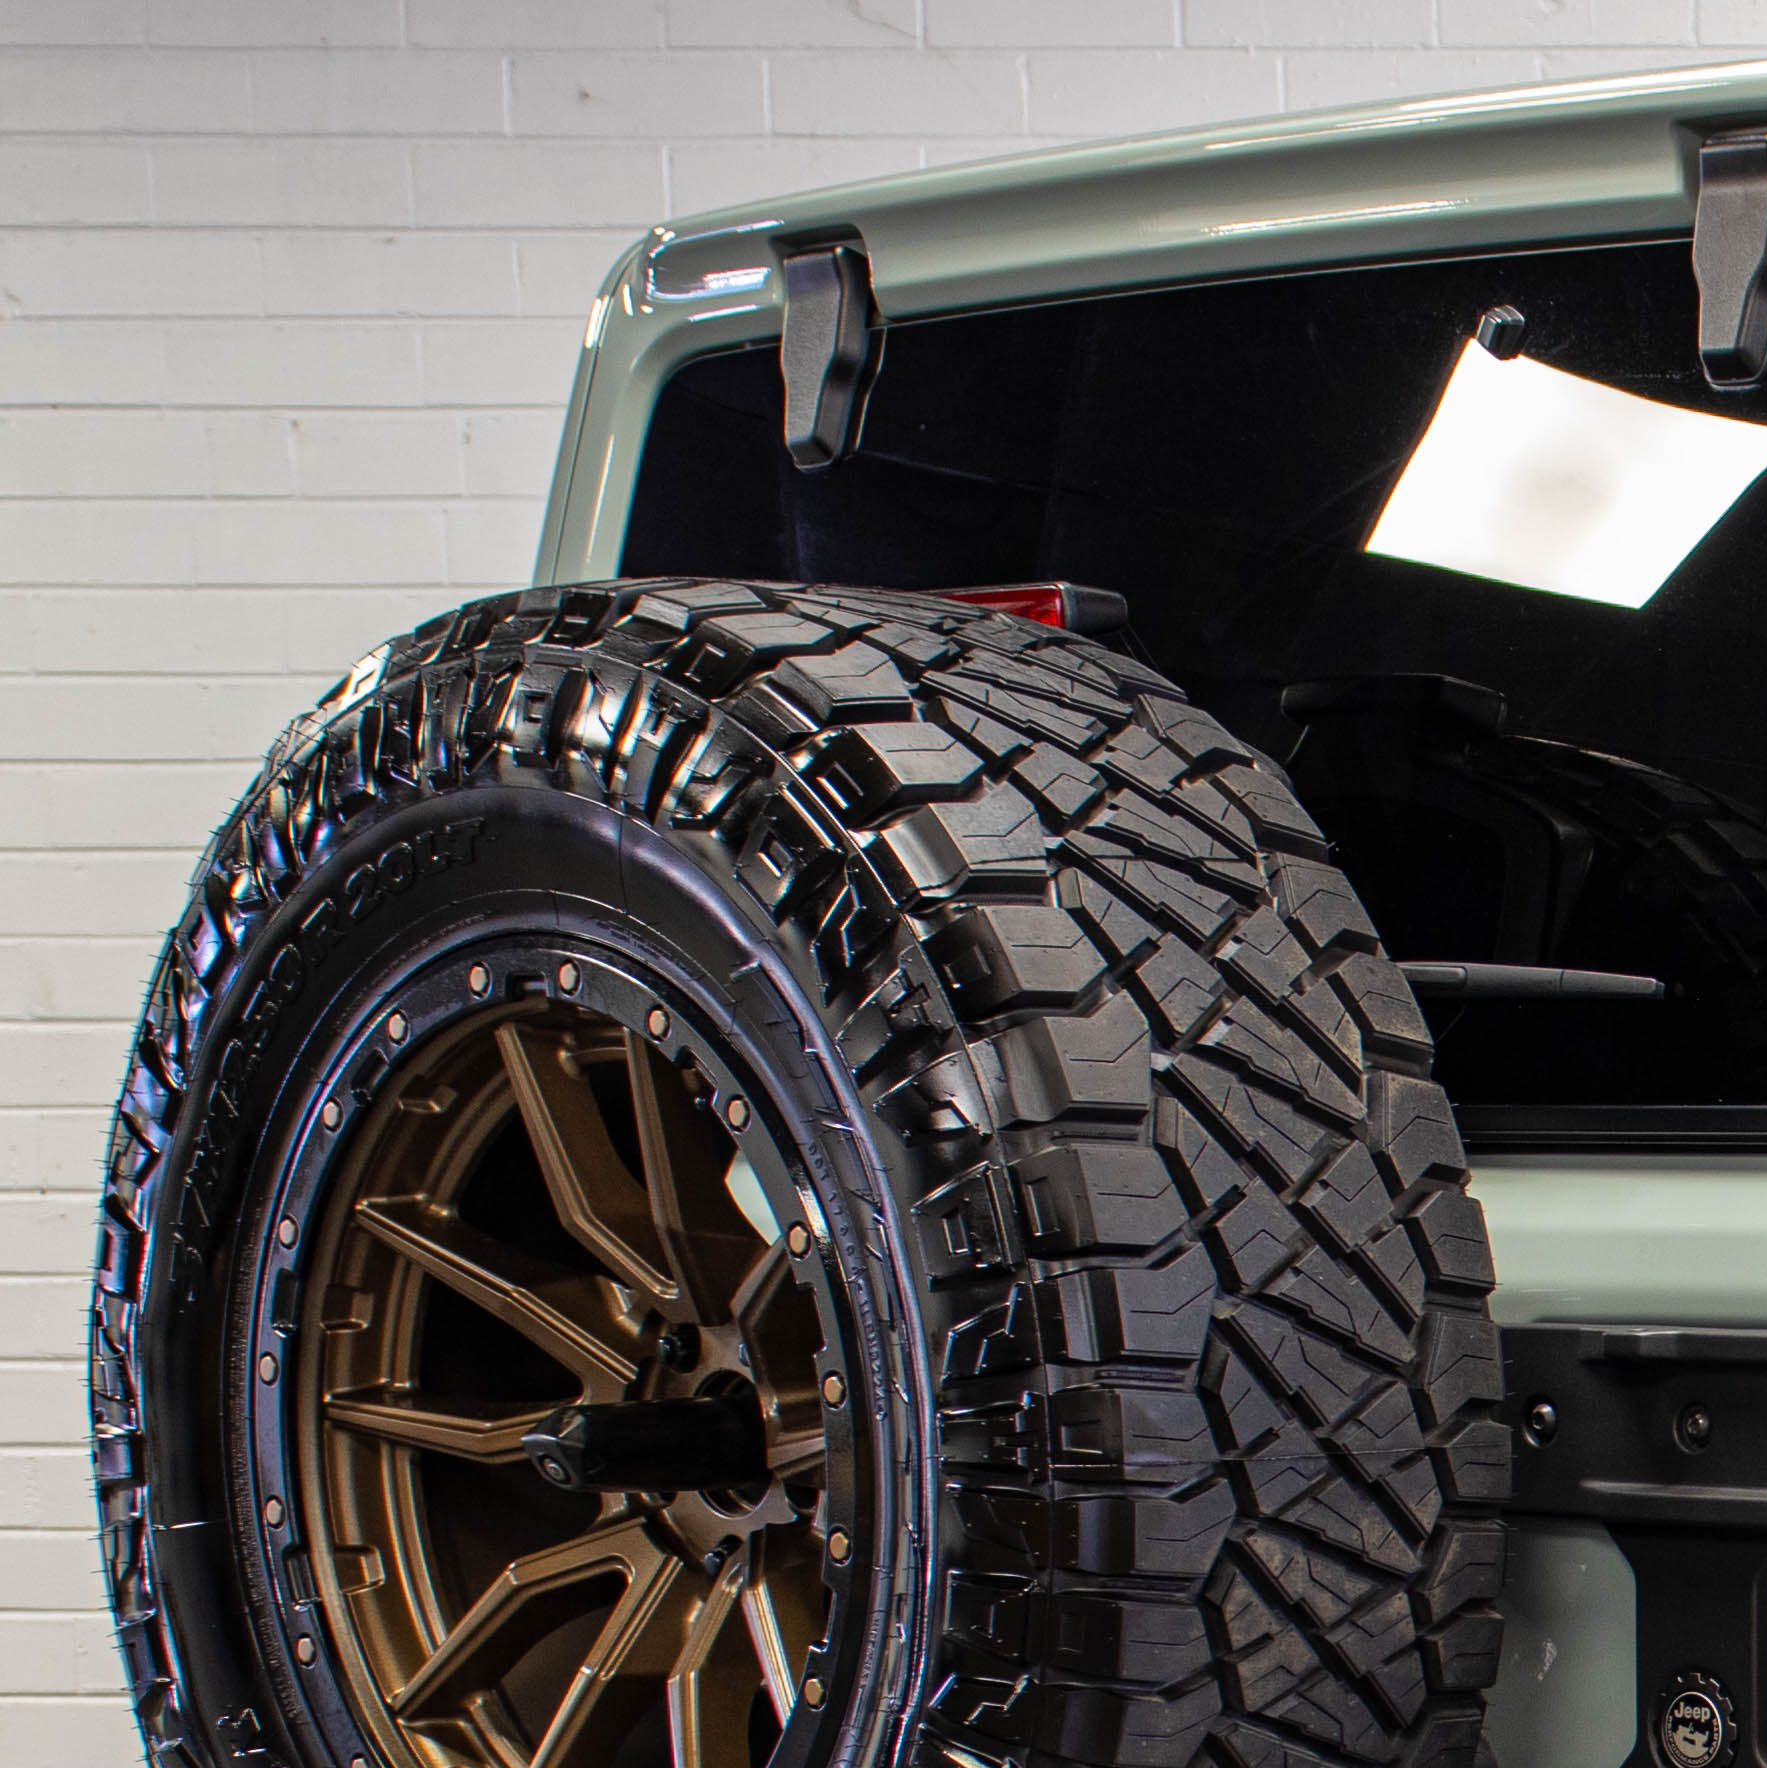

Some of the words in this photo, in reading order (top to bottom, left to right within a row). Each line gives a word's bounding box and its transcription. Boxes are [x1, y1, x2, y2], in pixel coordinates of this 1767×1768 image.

[1673, 1701, 1711, 1723] Jeep
[1667, 1715, 1709, 1765] PERFORMANCE
[1709, 1718, 1720, 1755] PARTS
